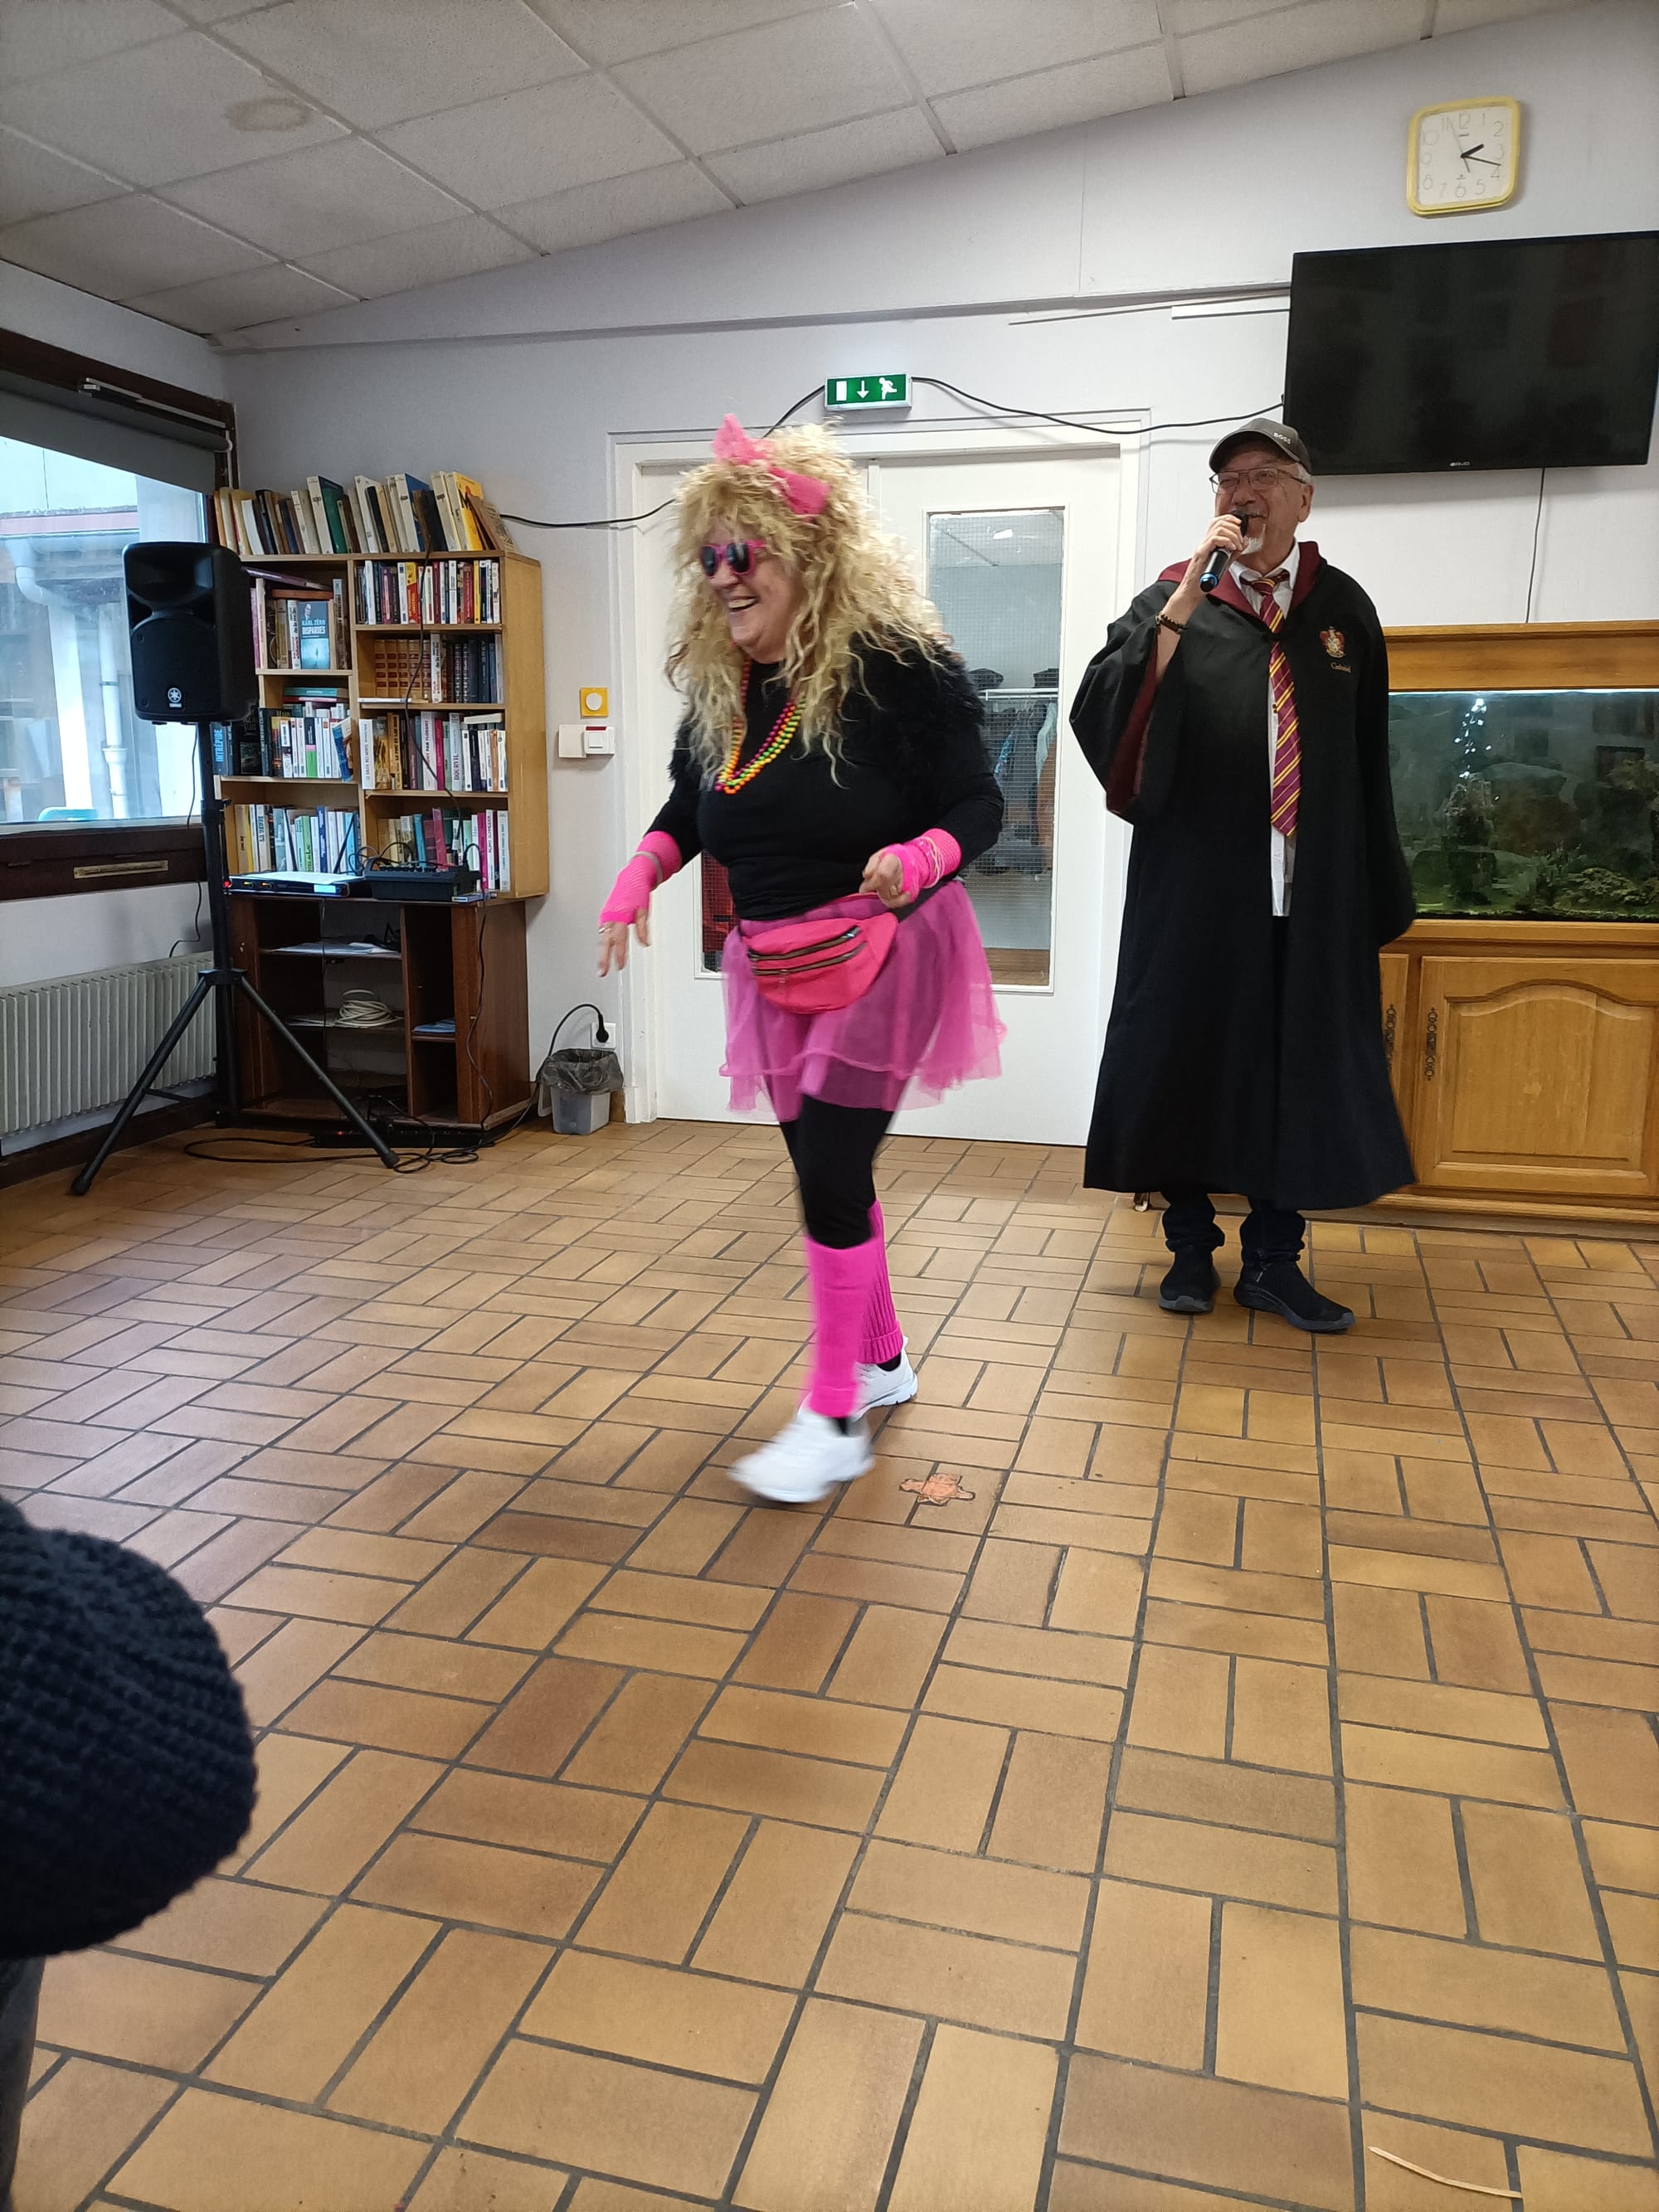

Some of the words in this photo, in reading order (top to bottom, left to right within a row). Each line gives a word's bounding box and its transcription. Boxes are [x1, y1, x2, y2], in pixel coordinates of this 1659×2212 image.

[1493, 121, 1505, 138] 2
[1490, 164, 1501, 180] 4
[1455, 182, 1467, 198] 6
[1475, 179, 1486, 195] 5
[213, 728, 225, 762] INTRÉPIDE
